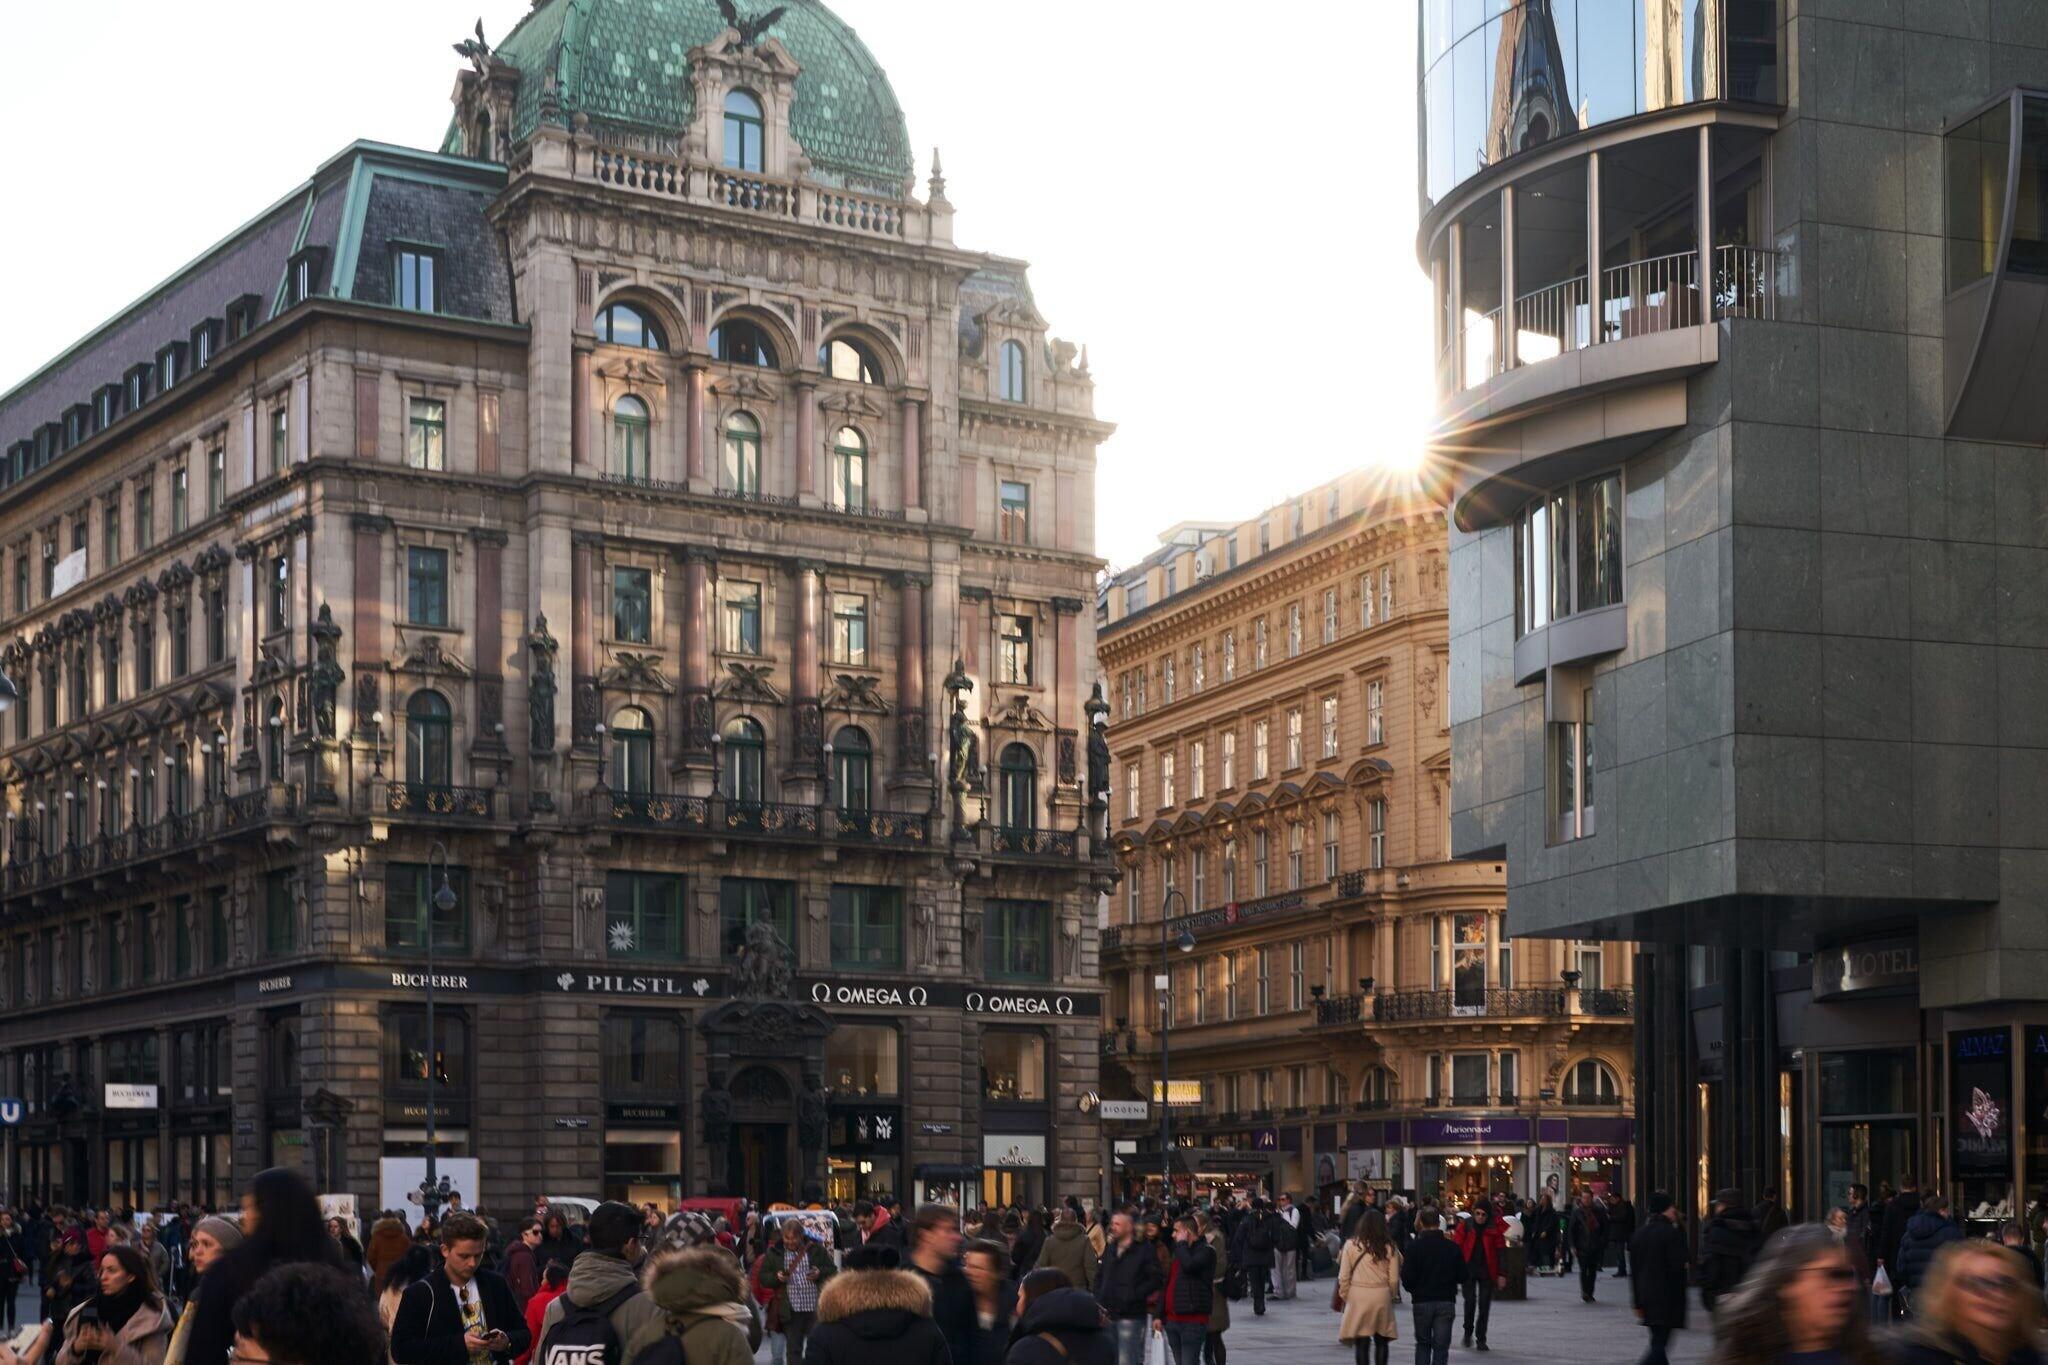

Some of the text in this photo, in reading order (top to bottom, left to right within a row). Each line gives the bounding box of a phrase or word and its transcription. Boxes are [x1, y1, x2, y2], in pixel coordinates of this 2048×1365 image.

[259, 976, 291, 992] BUCHERER
[392, 973, 468, 988] BUCHERER
[587, 975, 682, 994] PILSTL
[837, 987, 902, 1005] OMEGA
[989, 996, 1050, 1014] OMEGA
[1, 1102, 19, 1122] U
[404, 1106, 450, 1116] BUCHRER
[876, 1116, 892, 1139] WMF
[1441, 1123, 1492, 1136] Marionnaud
[999, 1154, 1033, 1164] OMEGA
[545, 1344, 606, 1365] VANS
